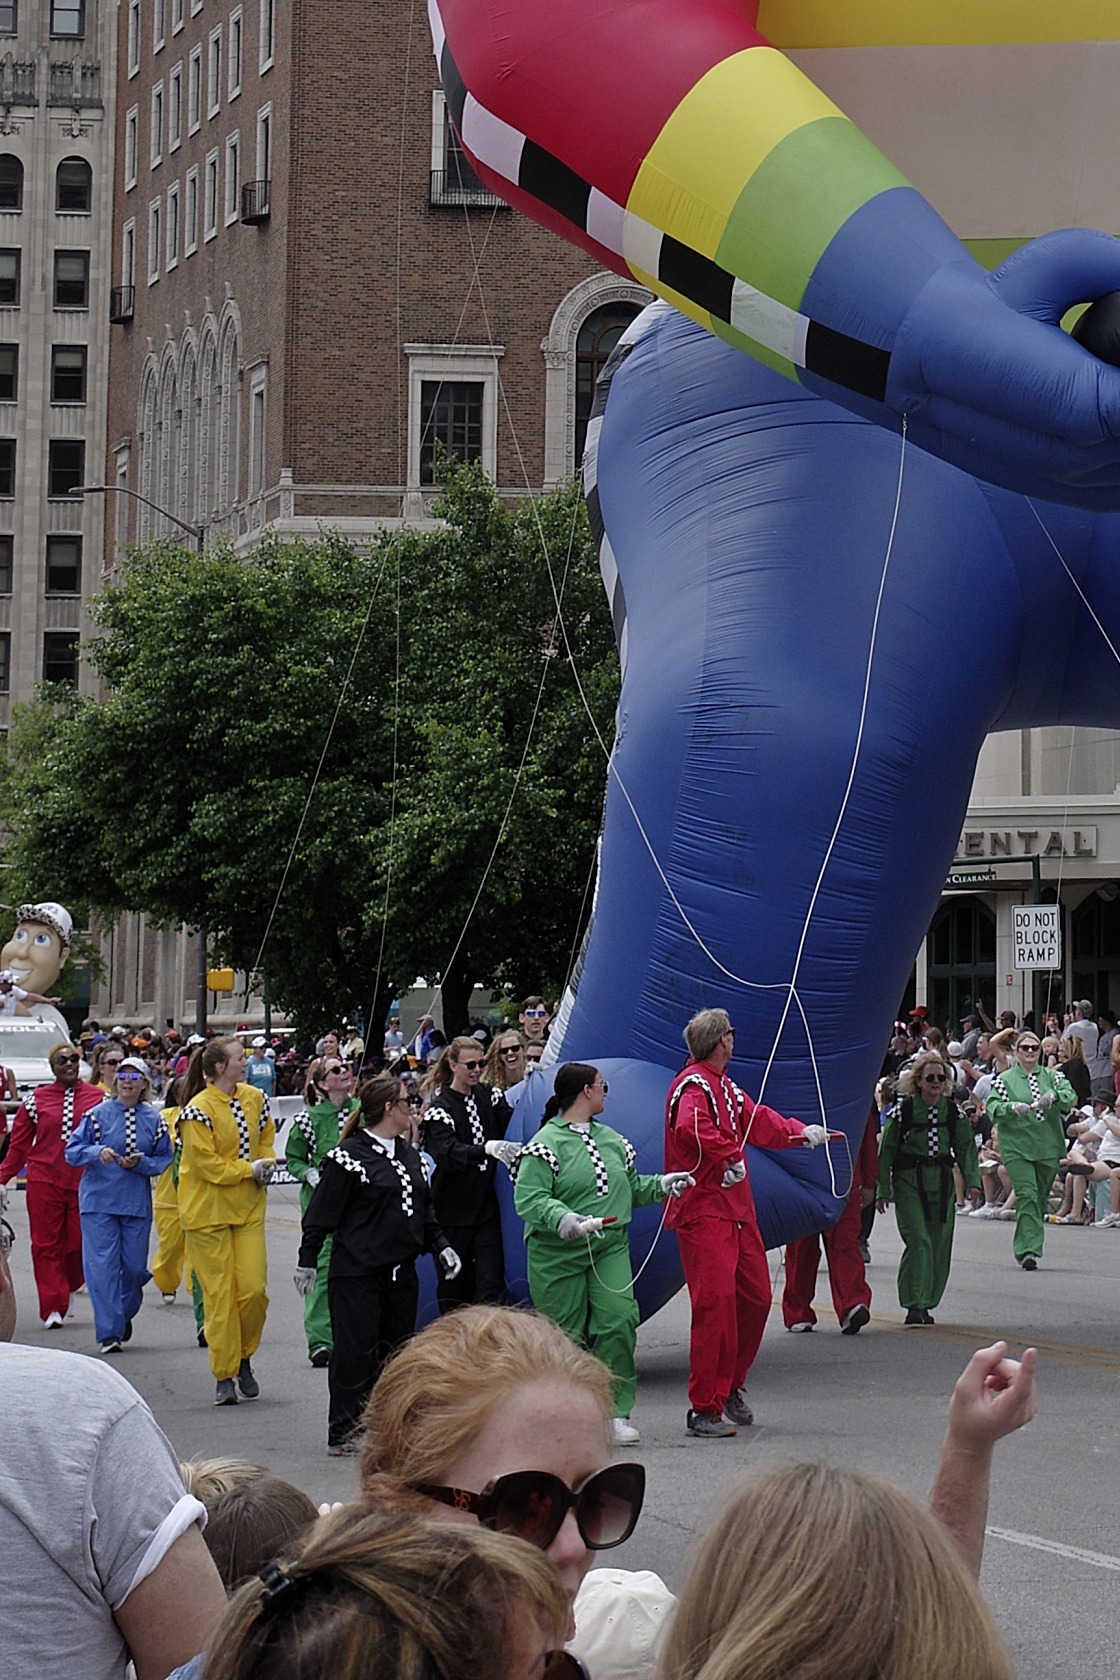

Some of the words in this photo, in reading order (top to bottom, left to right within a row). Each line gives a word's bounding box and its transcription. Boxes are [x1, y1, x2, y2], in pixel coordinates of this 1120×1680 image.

[957, 831, 1093, 856] ENTAL
[1016, 913, 1031, 928] DO
[1035, 912, 1056, 927] NOT
[1016, 930, 1057, 945] BLOCK
[1018, 947, 1056, 962] RAMP
